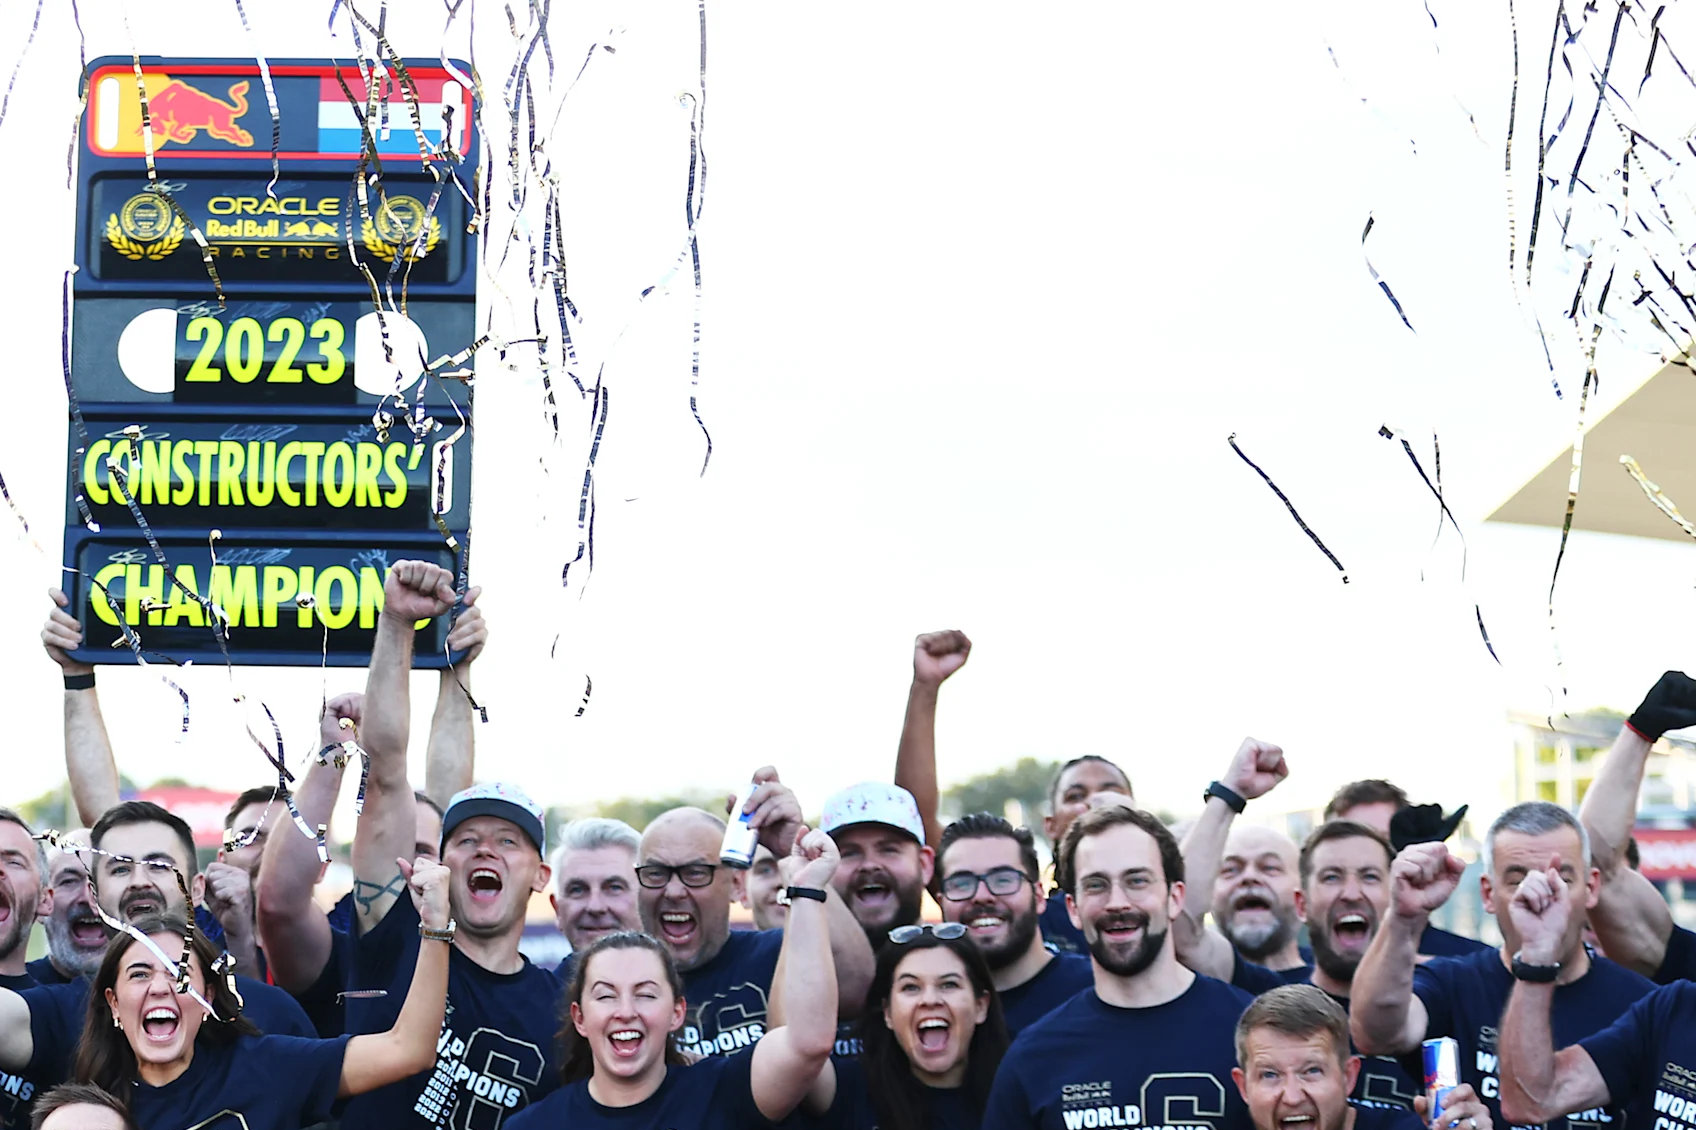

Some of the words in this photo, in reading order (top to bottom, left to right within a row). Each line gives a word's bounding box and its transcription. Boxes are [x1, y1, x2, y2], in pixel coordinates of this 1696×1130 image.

[207, 196, 340, 216] ORACLE
[207, 247, 340, 260] RACING
[184, 316, 347, 384] 2023
[83, 439, 422, 508] CONSTRUCTORS'
[90, 564, 432, 631] CHAMPION
[1063, 1105, 1141, 1130] WORLD
